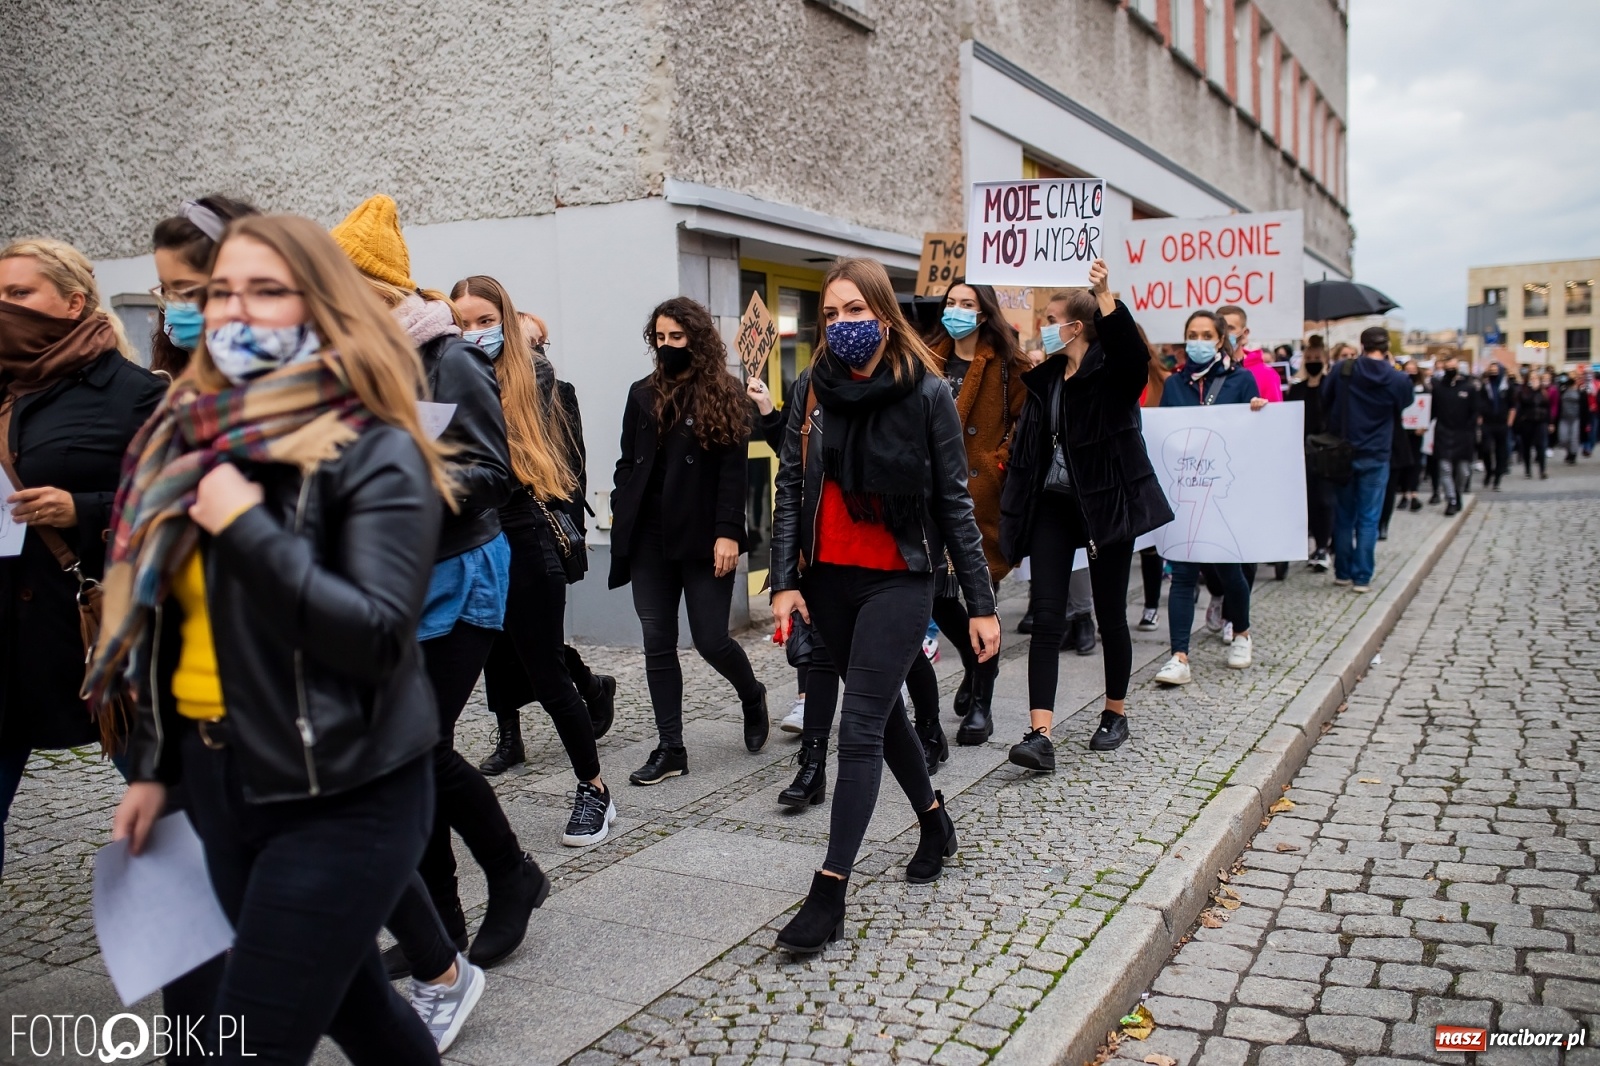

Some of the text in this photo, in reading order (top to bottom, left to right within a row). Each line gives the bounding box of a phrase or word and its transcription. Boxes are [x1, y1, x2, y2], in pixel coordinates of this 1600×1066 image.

[984, 182, 1102, 222] MOJE CIAŁO
[982, 223, 1100, 268] MÓJ WYBÓR
[1126, 223, 1281, 264] W OBRONIE
[1131, 265, 1274, 311] WOLNOŚCI
[1174, 456, 1217, 476] STRAJK
[1177, 476, 1222, 488] KOBIET
